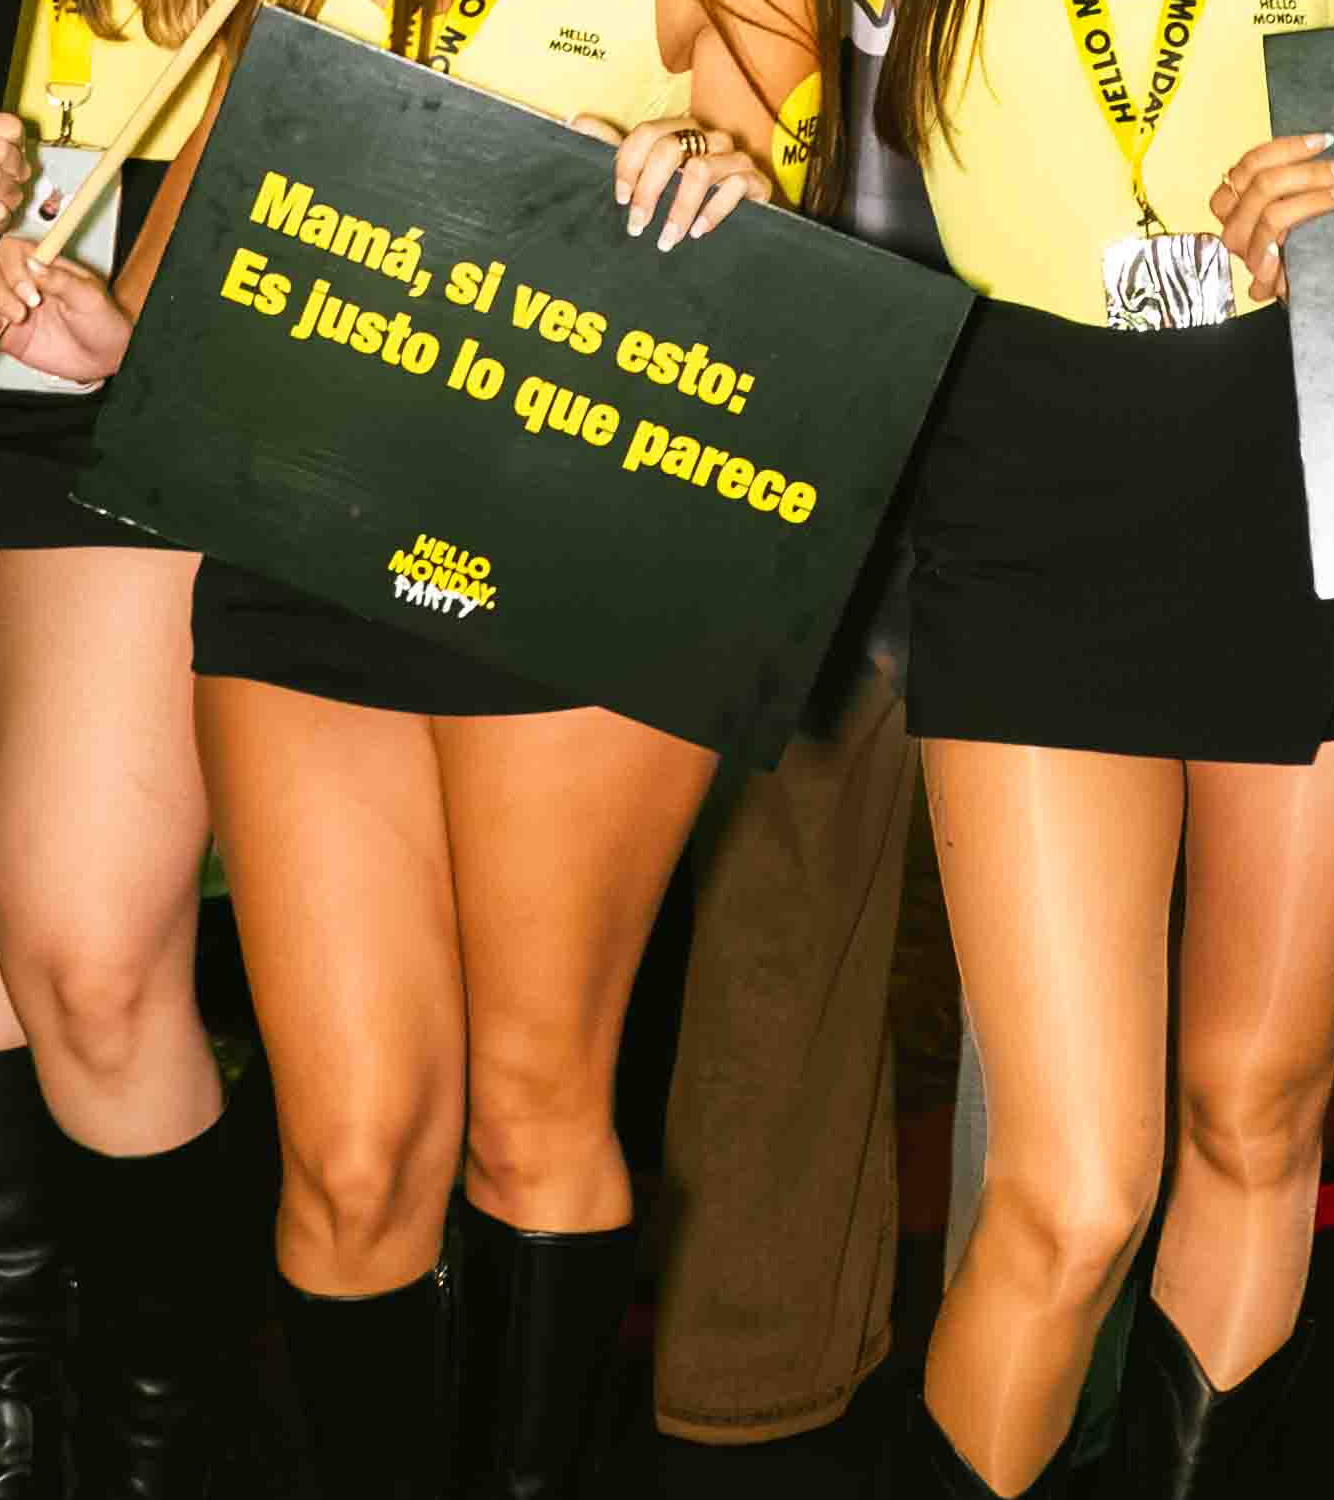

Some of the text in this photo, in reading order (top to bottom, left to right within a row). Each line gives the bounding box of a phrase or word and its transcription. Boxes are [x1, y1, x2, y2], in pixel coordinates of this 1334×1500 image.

[1259, 0, 1297, 10] HELLO
[559, 26, 600, 44] HELLO
[1084, 28, 1137, 124] HELLO
[250, 171, 754, 415] Mamá, si ves esto:
[220, 247, 817, 524] Es justo lo que parece
[388, 549, 497, 610] MONDAY.
[412, 533, 492, 580] HELLO
[394, 573, 479, 619] PARTY
